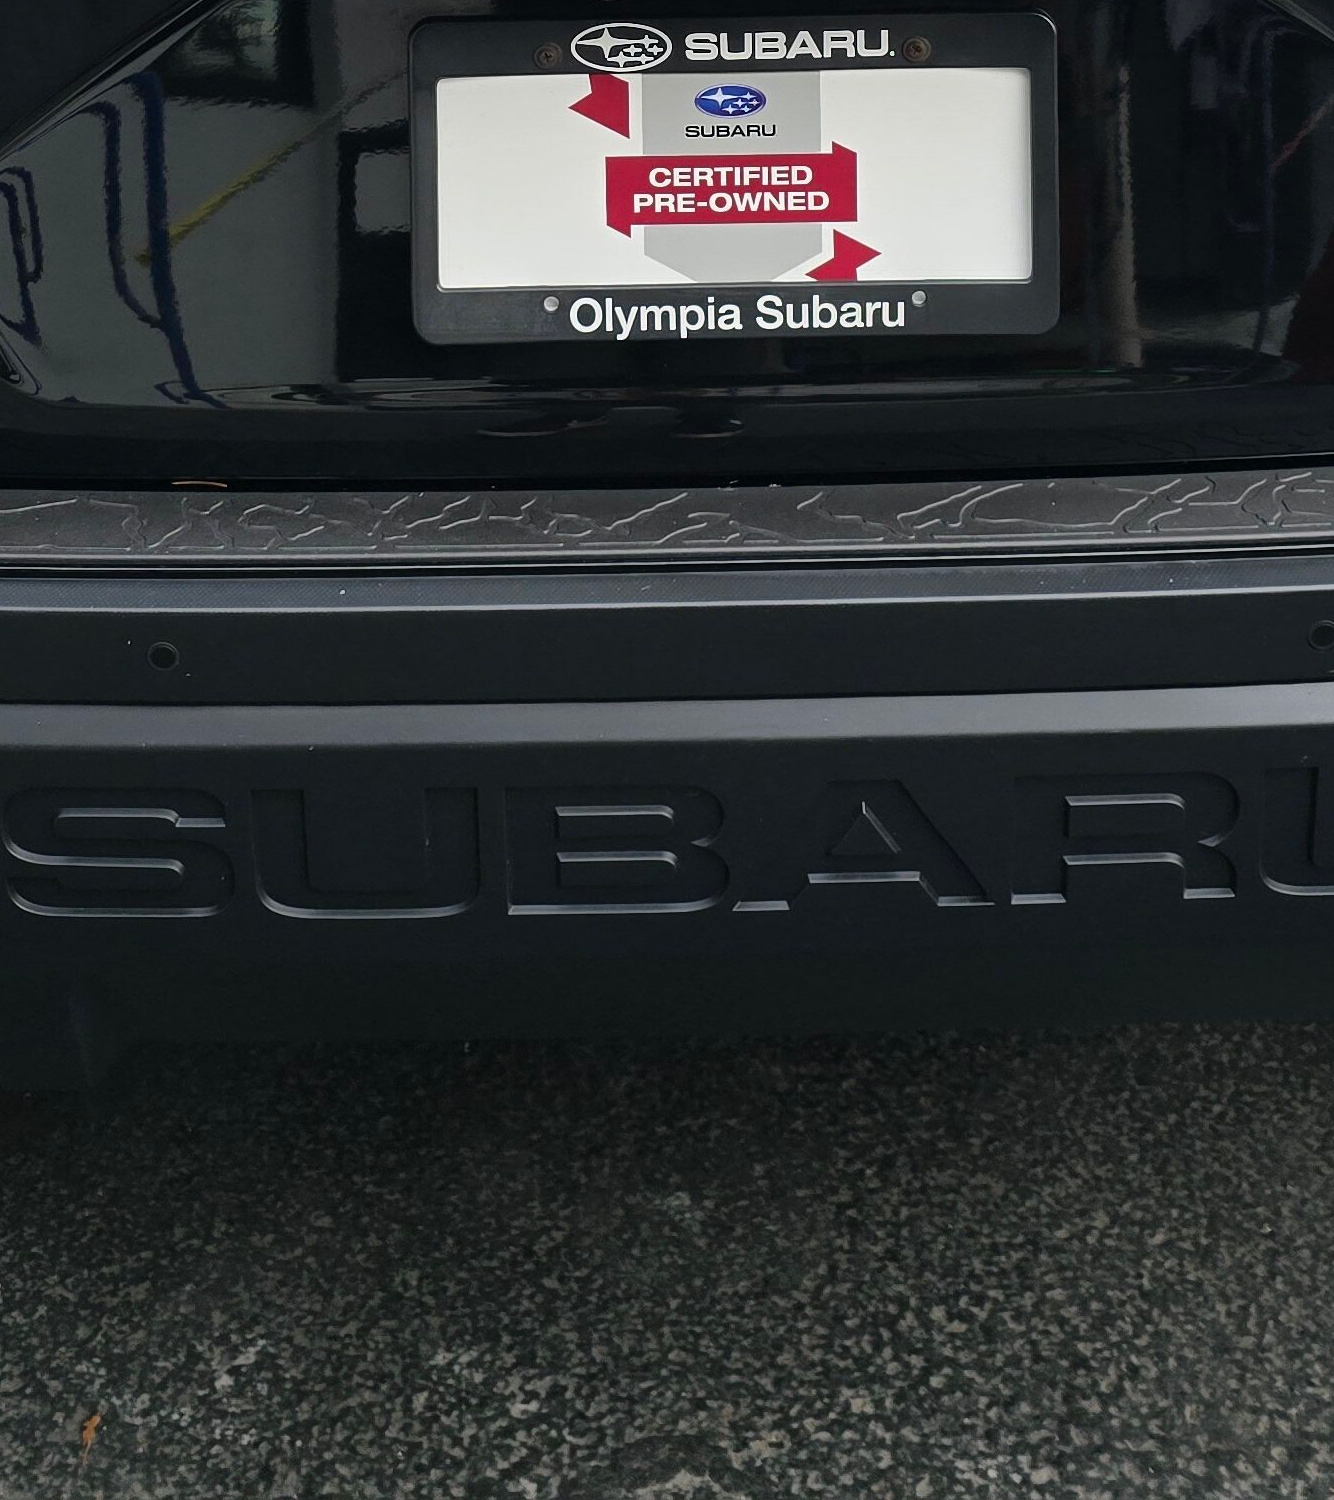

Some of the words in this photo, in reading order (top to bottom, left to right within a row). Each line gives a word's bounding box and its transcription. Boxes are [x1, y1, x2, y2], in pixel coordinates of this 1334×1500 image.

[685, 124, 777, 138] SUBARU
[648, 166, 813, 188] CERTIFIED
[633, 191, 831, 214] PRE-OWNED
[569, 296, 743, 340] Olympia
[756, 294, 906, 330] Subaru
